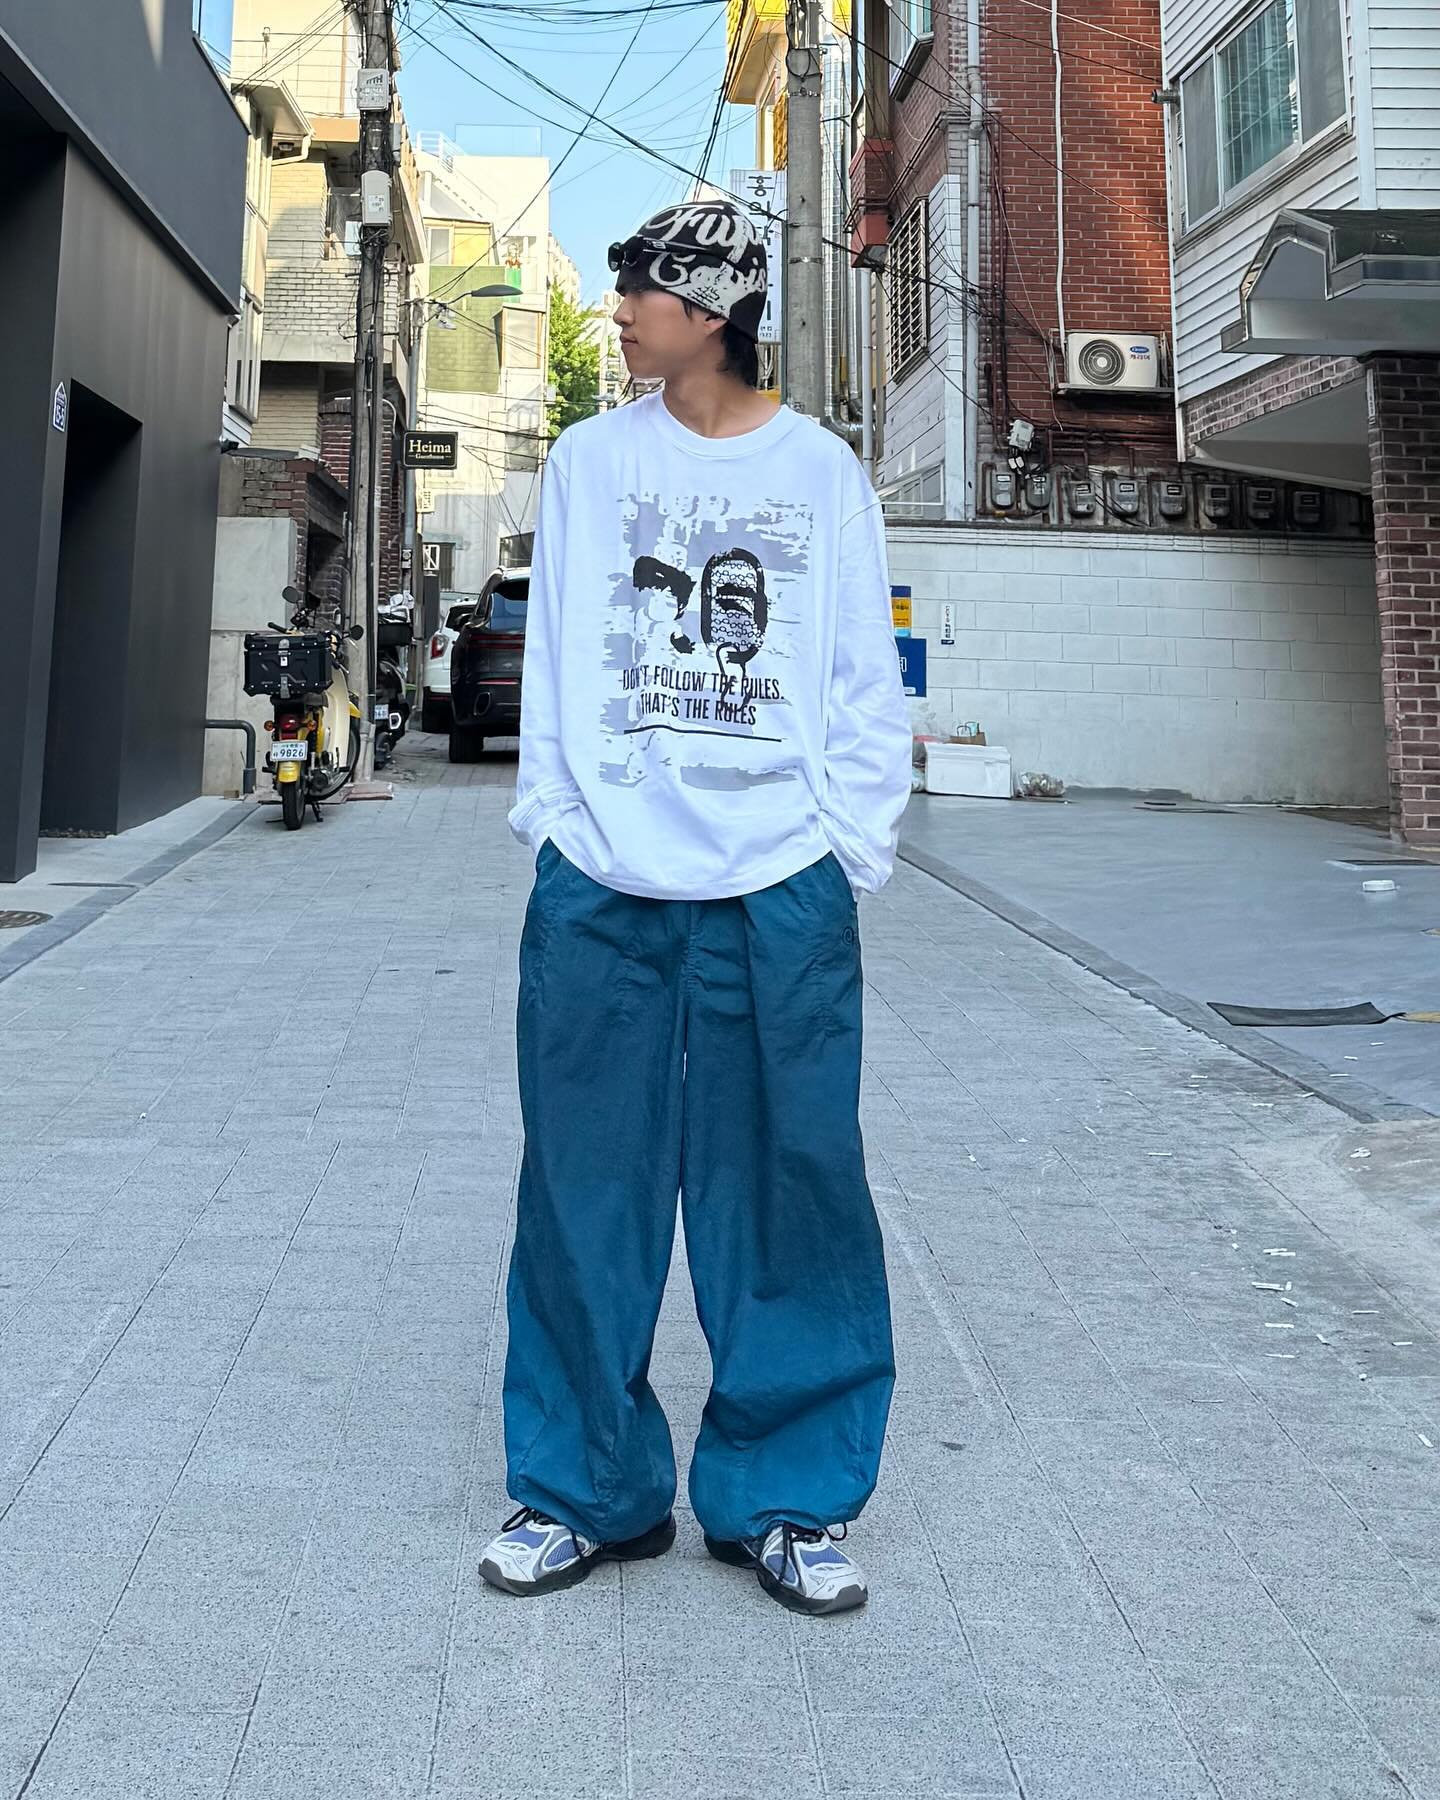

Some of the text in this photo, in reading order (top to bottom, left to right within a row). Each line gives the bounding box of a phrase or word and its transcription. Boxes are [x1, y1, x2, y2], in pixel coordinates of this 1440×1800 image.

[408, 439, 452, 453] Heima
[622, 664, 650, 691] DON'T
[653, 665, 707, 692] FOLLOW
[640, 692, 757, 726] THAT'S THE RULES
